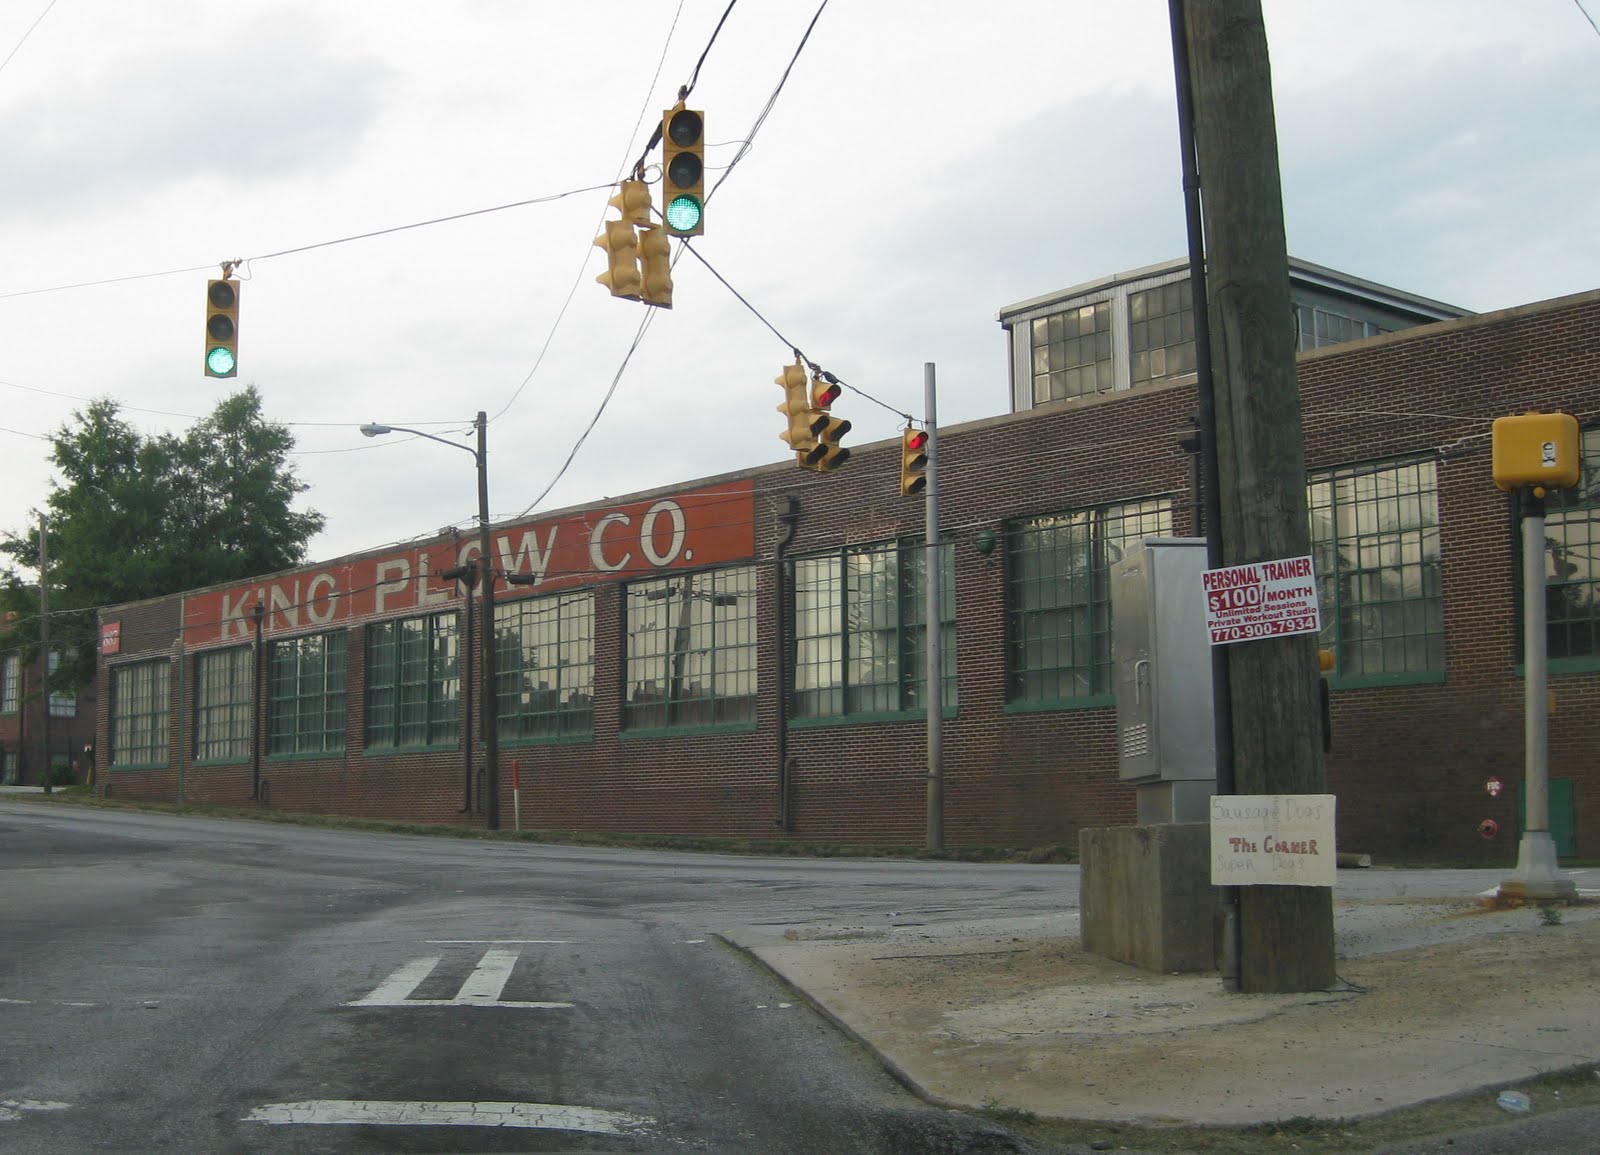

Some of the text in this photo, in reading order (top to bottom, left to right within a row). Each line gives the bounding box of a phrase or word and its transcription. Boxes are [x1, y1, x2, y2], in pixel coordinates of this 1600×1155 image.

[221, 573, 341, 640] KING
[590, 500, 694, 574] CO.
[1203, 559, 1312, 590] PERSONAL TRAINER
[1208, 607, 1317, 628] Private Workout Studio
[1216, 600, 1307, 618] Unlimited Sessions
[1213, 617, 1315, 642] 770-900-7934
